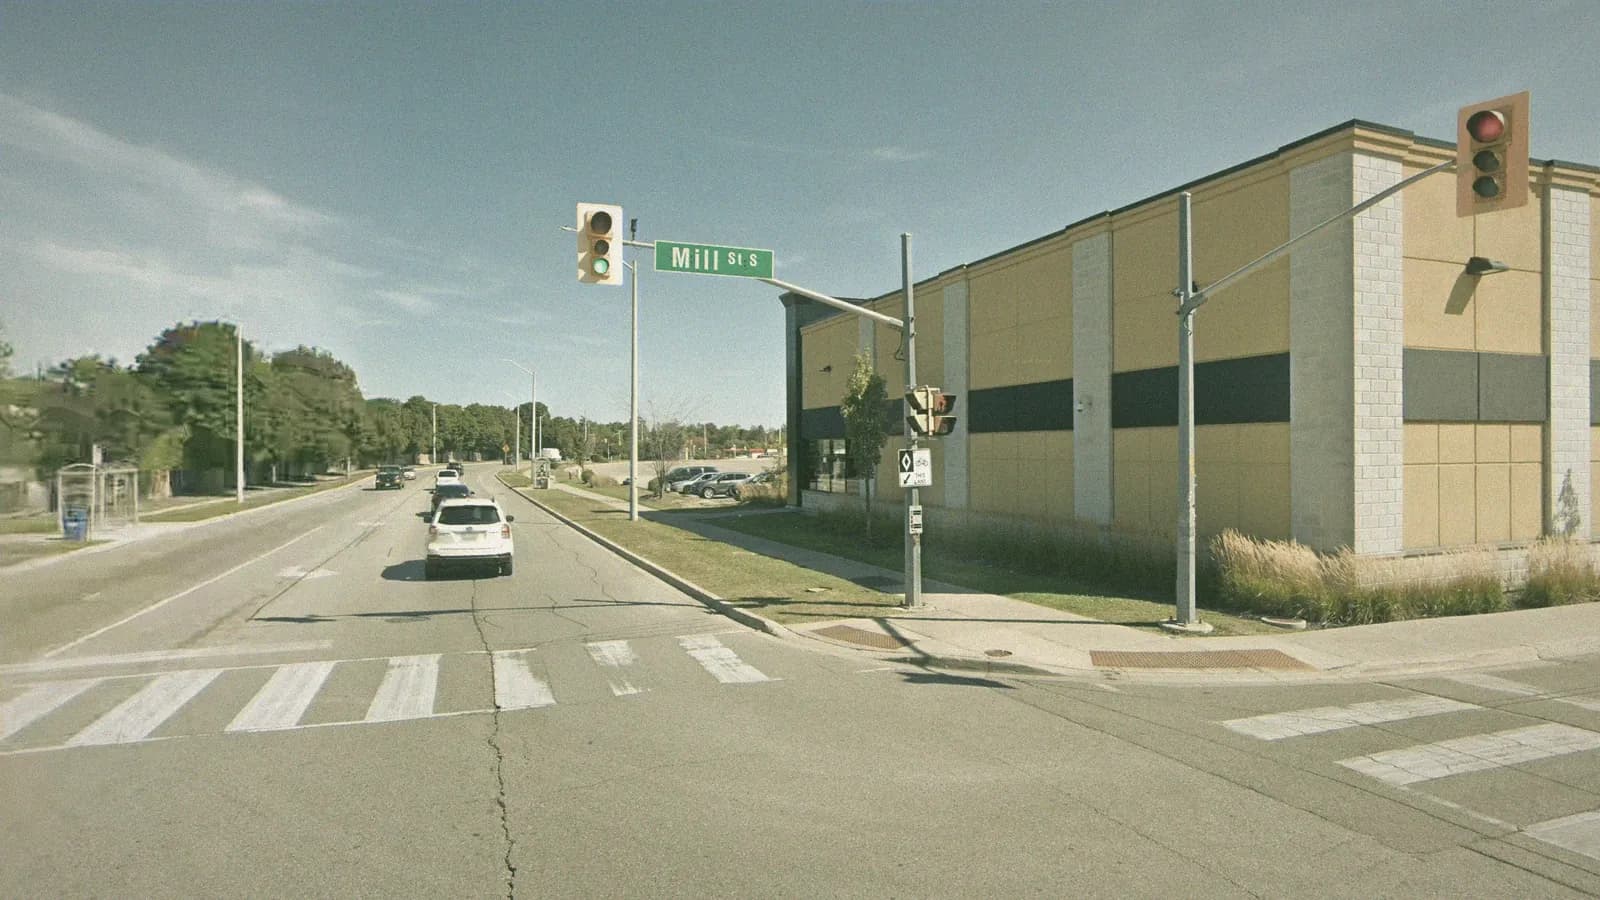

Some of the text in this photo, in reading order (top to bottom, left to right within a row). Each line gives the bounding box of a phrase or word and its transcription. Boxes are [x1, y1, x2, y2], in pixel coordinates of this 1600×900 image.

[672, 247, 758, 271] Mill St S
